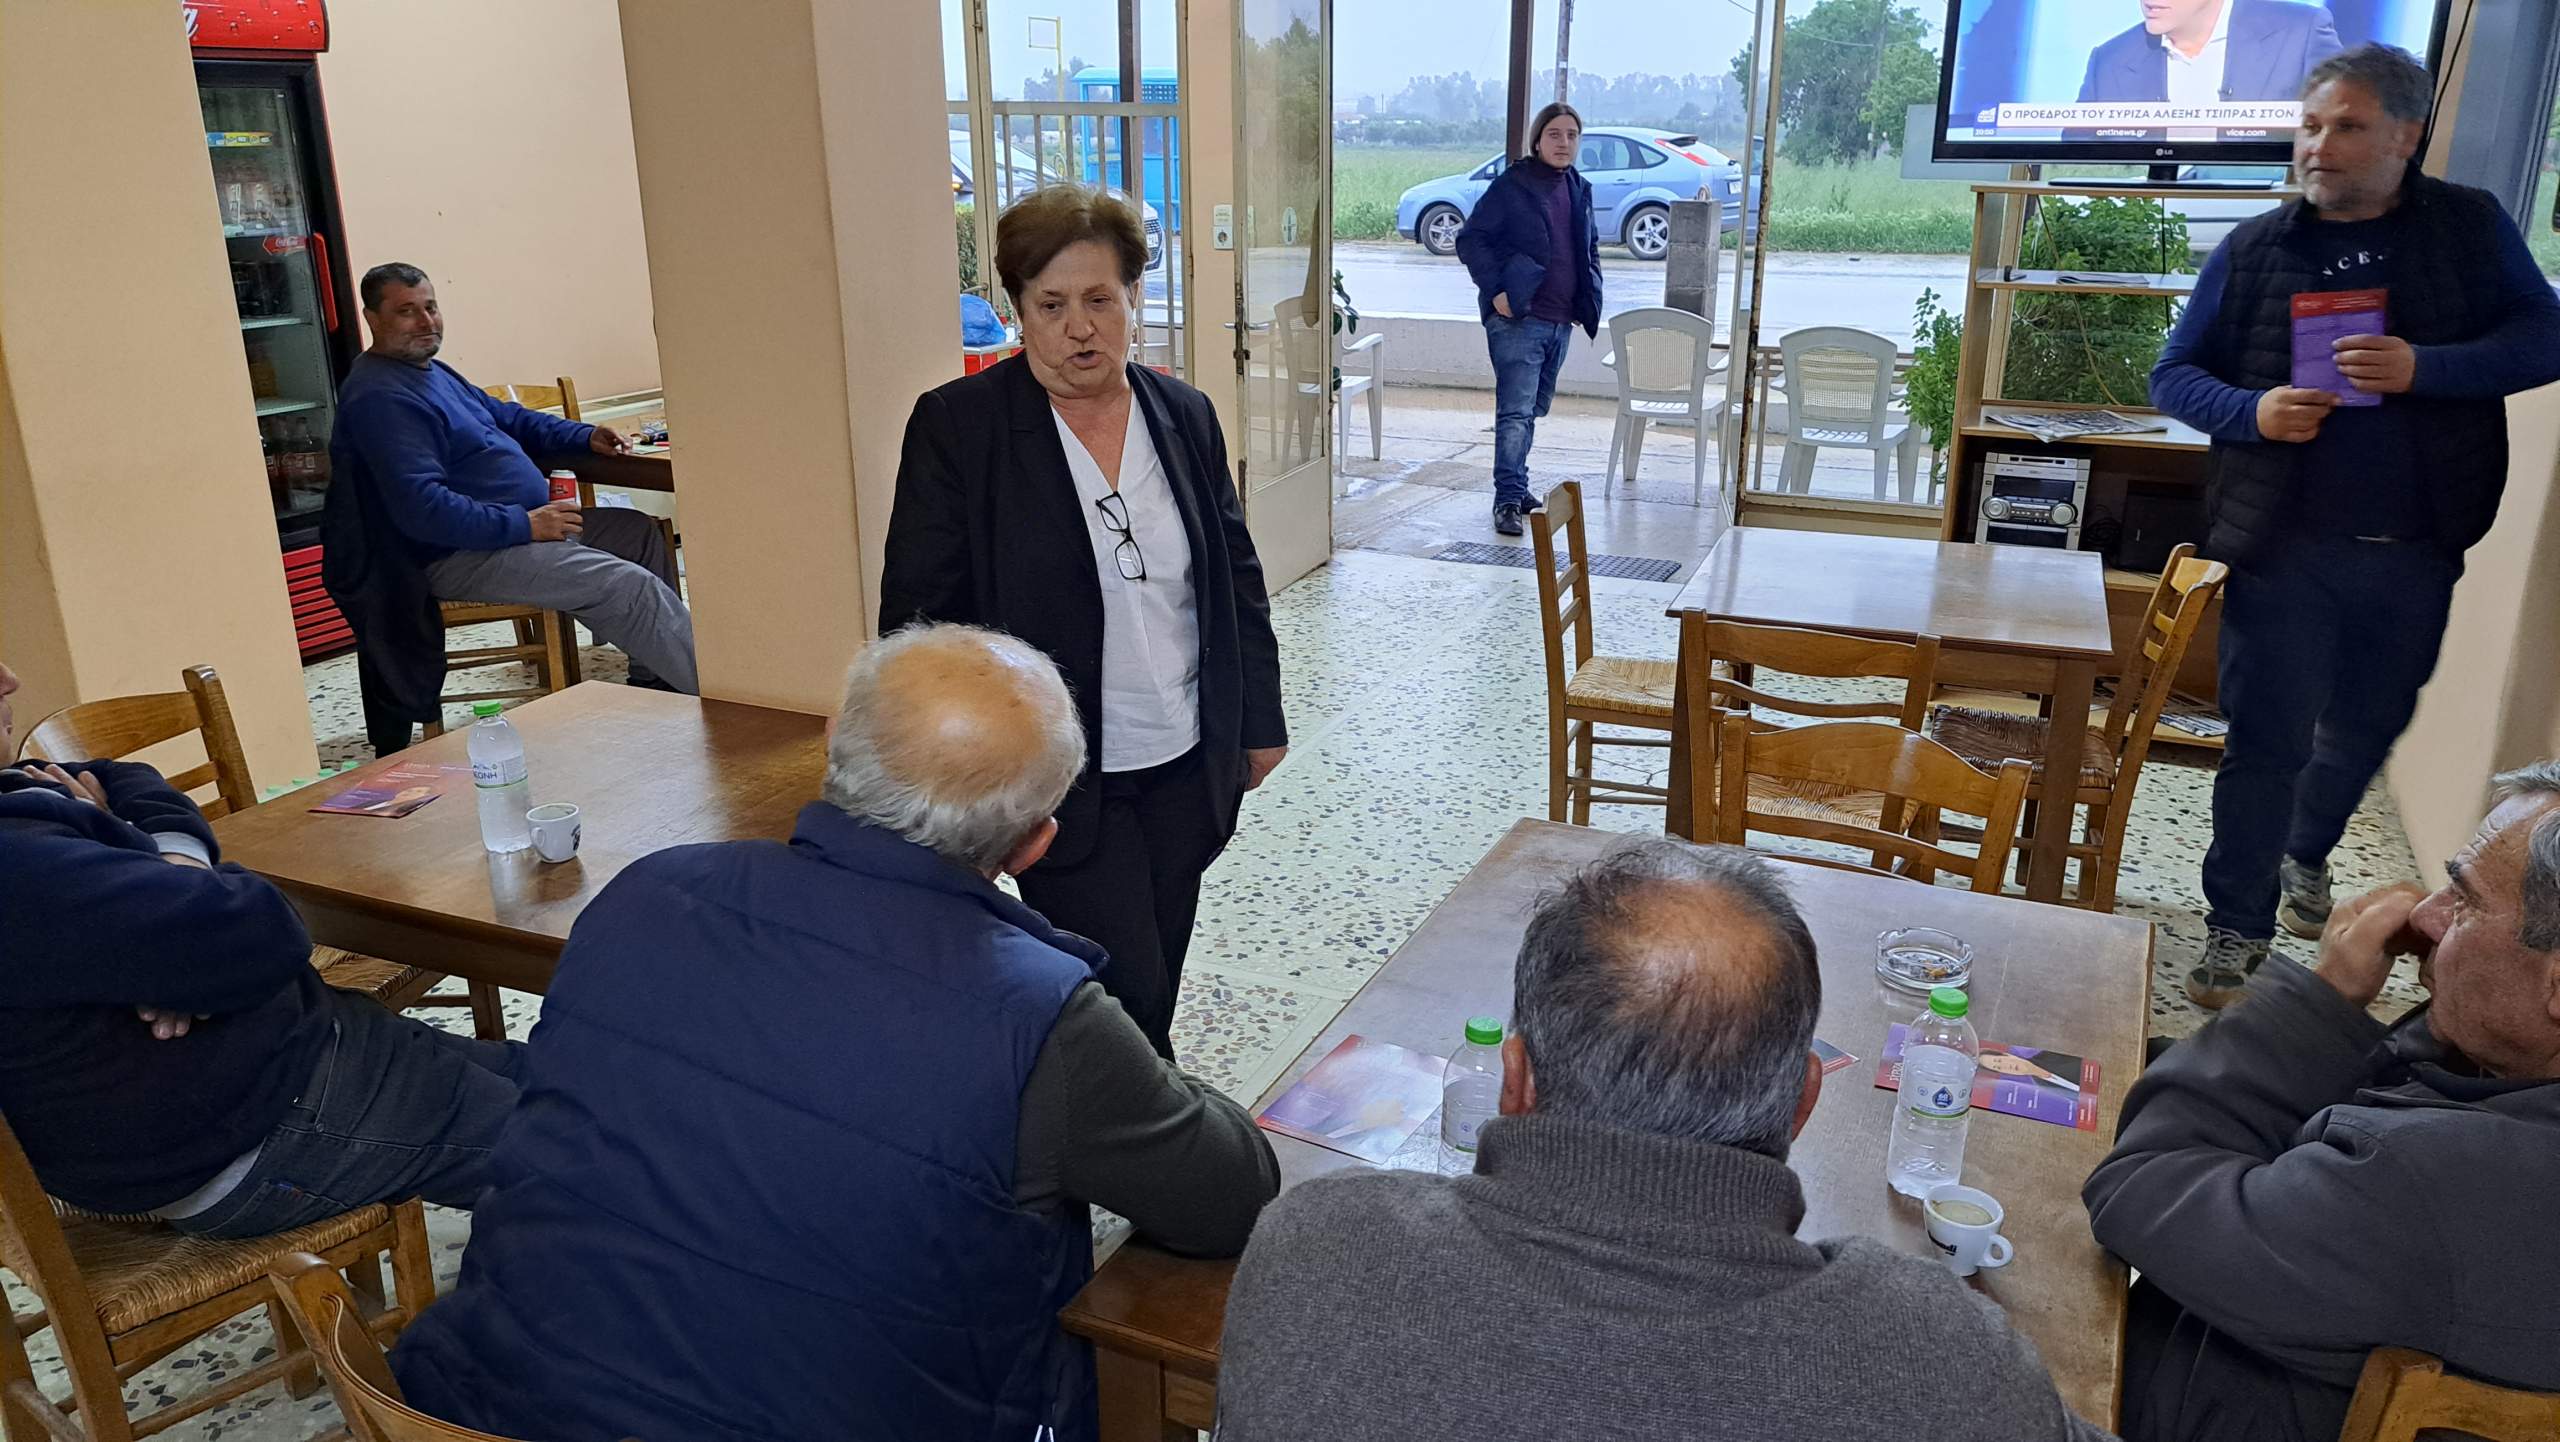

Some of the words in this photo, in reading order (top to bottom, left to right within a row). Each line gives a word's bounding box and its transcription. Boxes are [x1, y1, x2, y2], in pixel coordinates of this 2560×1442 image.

[2002, 110, 2011, 119] Ο
[2015, 109, 2077, 119] ΠΡΟΕΔΡΟΣ
[2081, 109, 2105, 119] ΤΟΥ
[2108, 109, 2150, 119] ΣΥΡΙΖΑ
[2153, 108, 2201, 119] ΑΛΕΞΗΣ
[2205, 108, 2257, 119] ΤΣΙΠΡΑΣ
[2260, 108, 2295, 119] ΣΤΟΝ
